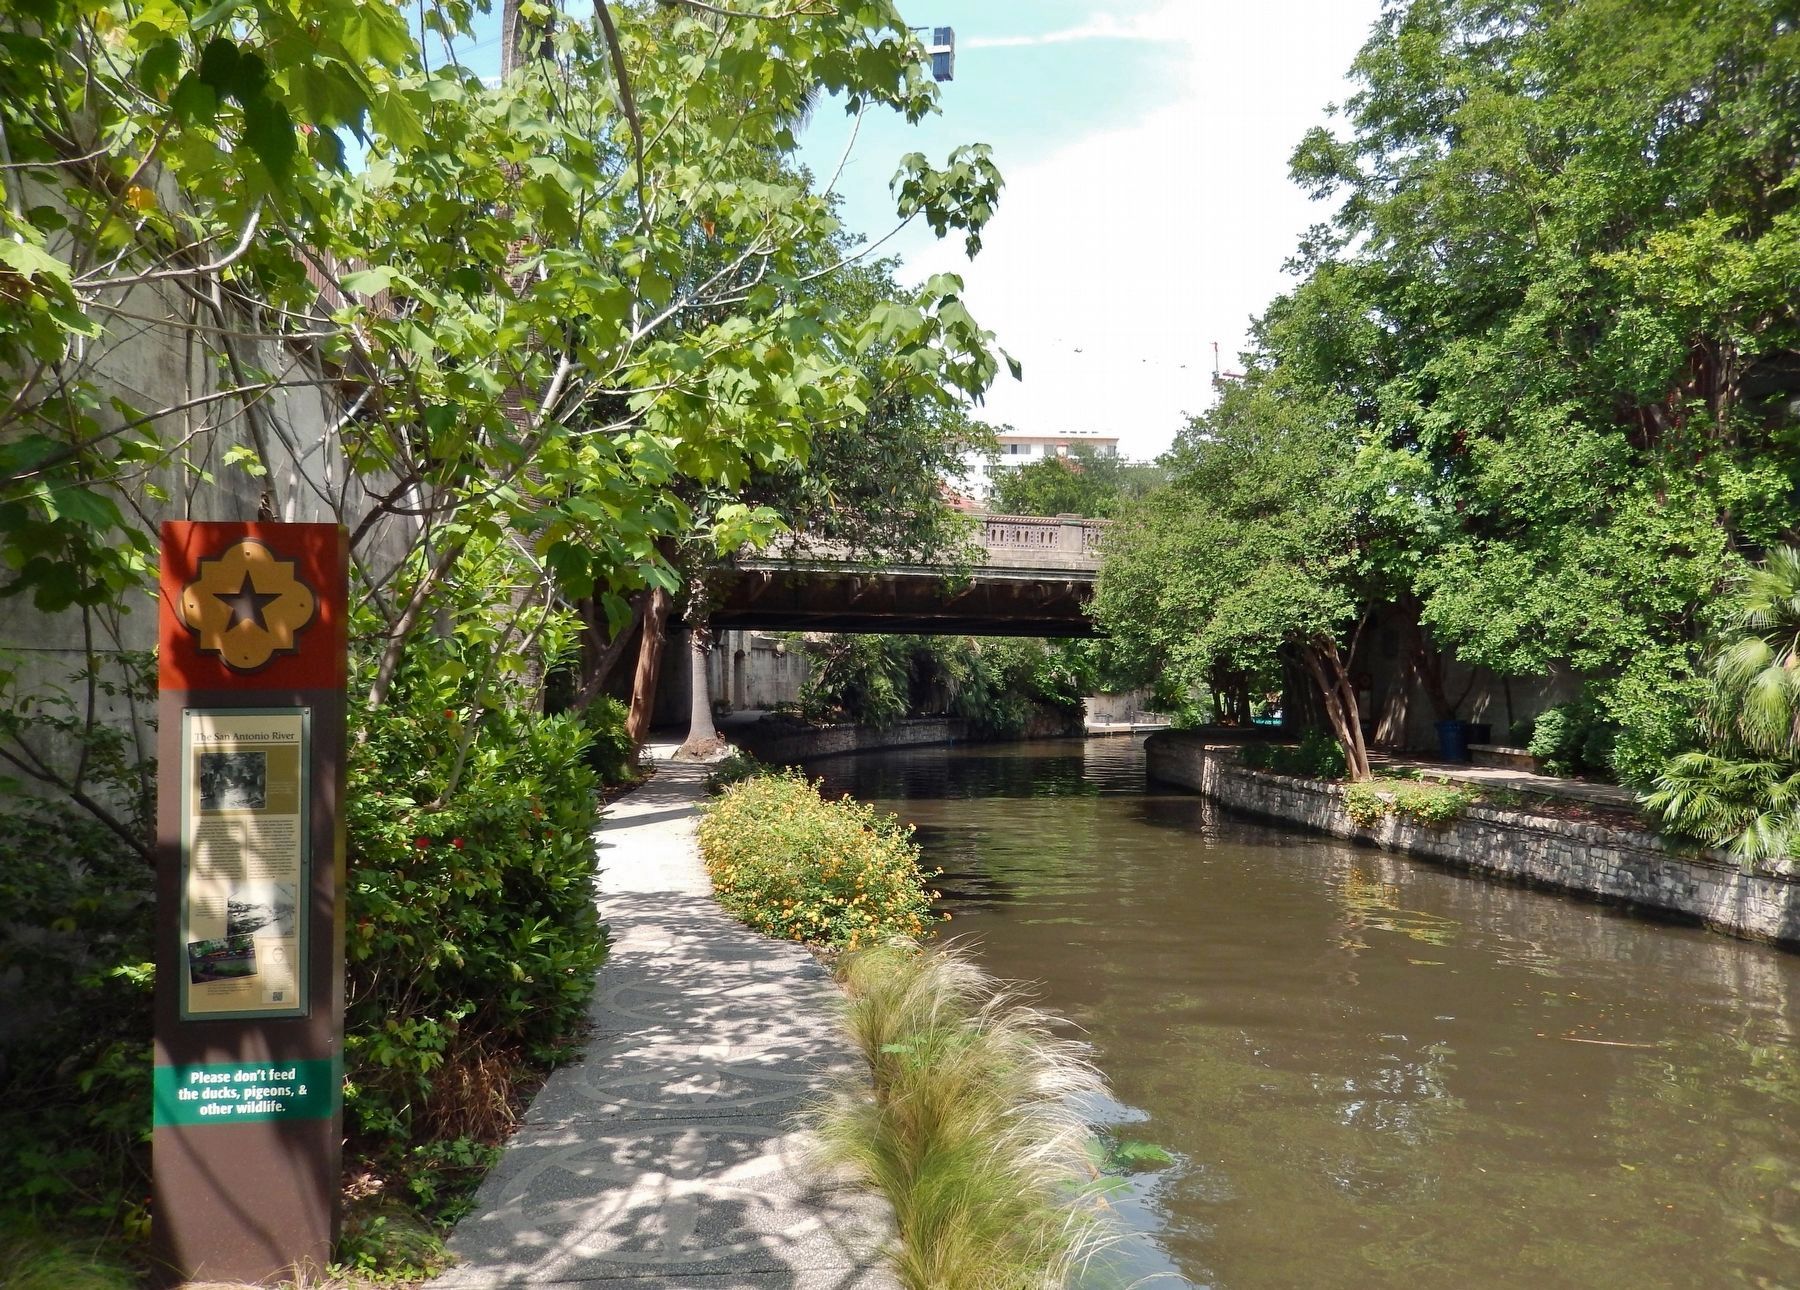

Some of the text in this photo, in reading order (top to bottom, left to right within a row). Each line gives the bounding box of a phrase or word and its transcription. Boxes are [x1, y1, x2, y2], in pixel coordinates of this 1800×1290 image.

[214, 732, 230, 740] San
[232, 732, 269, 740] Antonio
[272, 732, 295, 740] River
[191, 1072, 230, 1083] Please
[269, 1068, 295, 1080] feed
[178, 1085, 307, 1100] the ducks, pigeons, &
[200, 1100, 285, 1115] other wildlife.
